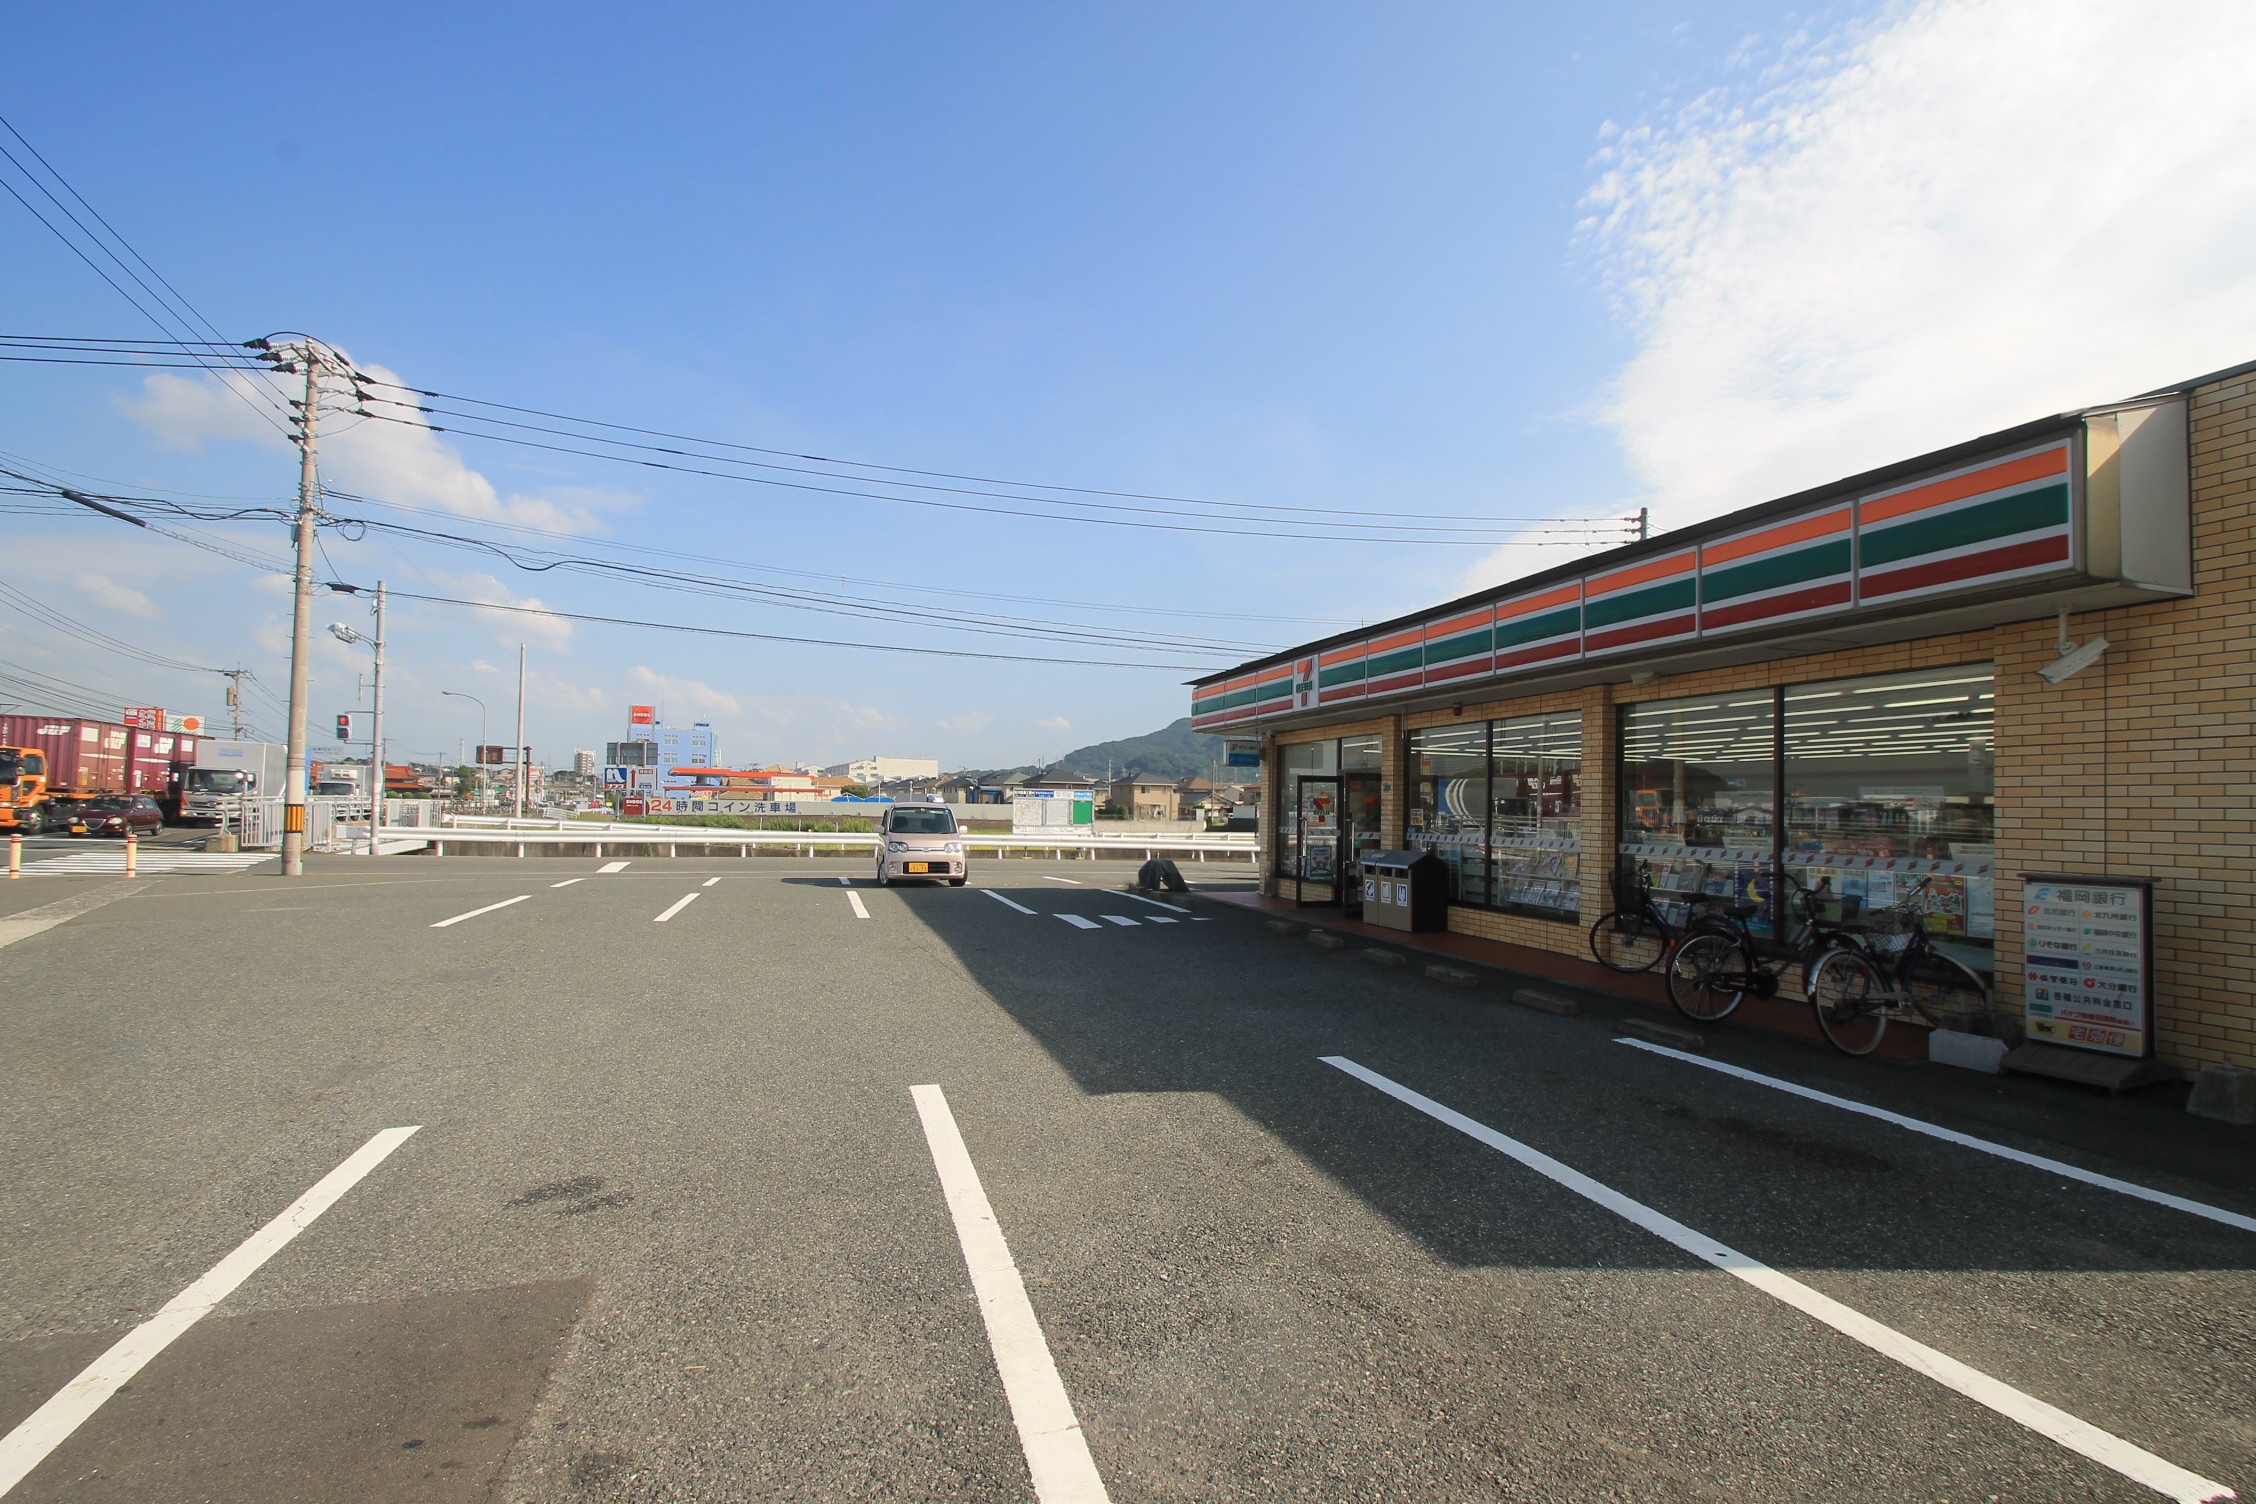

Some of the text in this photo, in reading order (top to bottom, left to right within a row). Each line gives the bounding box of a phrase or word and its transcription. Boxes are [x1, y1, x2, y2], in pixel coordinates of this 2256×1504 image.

[651, 799, 797, 814] 24時間コイン洗車場
[2056, 888, 2127, 906] 福岡銀行
[2094, 912, 2136, 922] 北九州銀行
[2038, 940, 2078, 951] りそな銀行
[2097, 981, 2137, 993] 大分銀行
[2053, 991, 2132, 1011] 各種公共料金窓口
[2071, 1026, 2125, 1047] 宅急便
